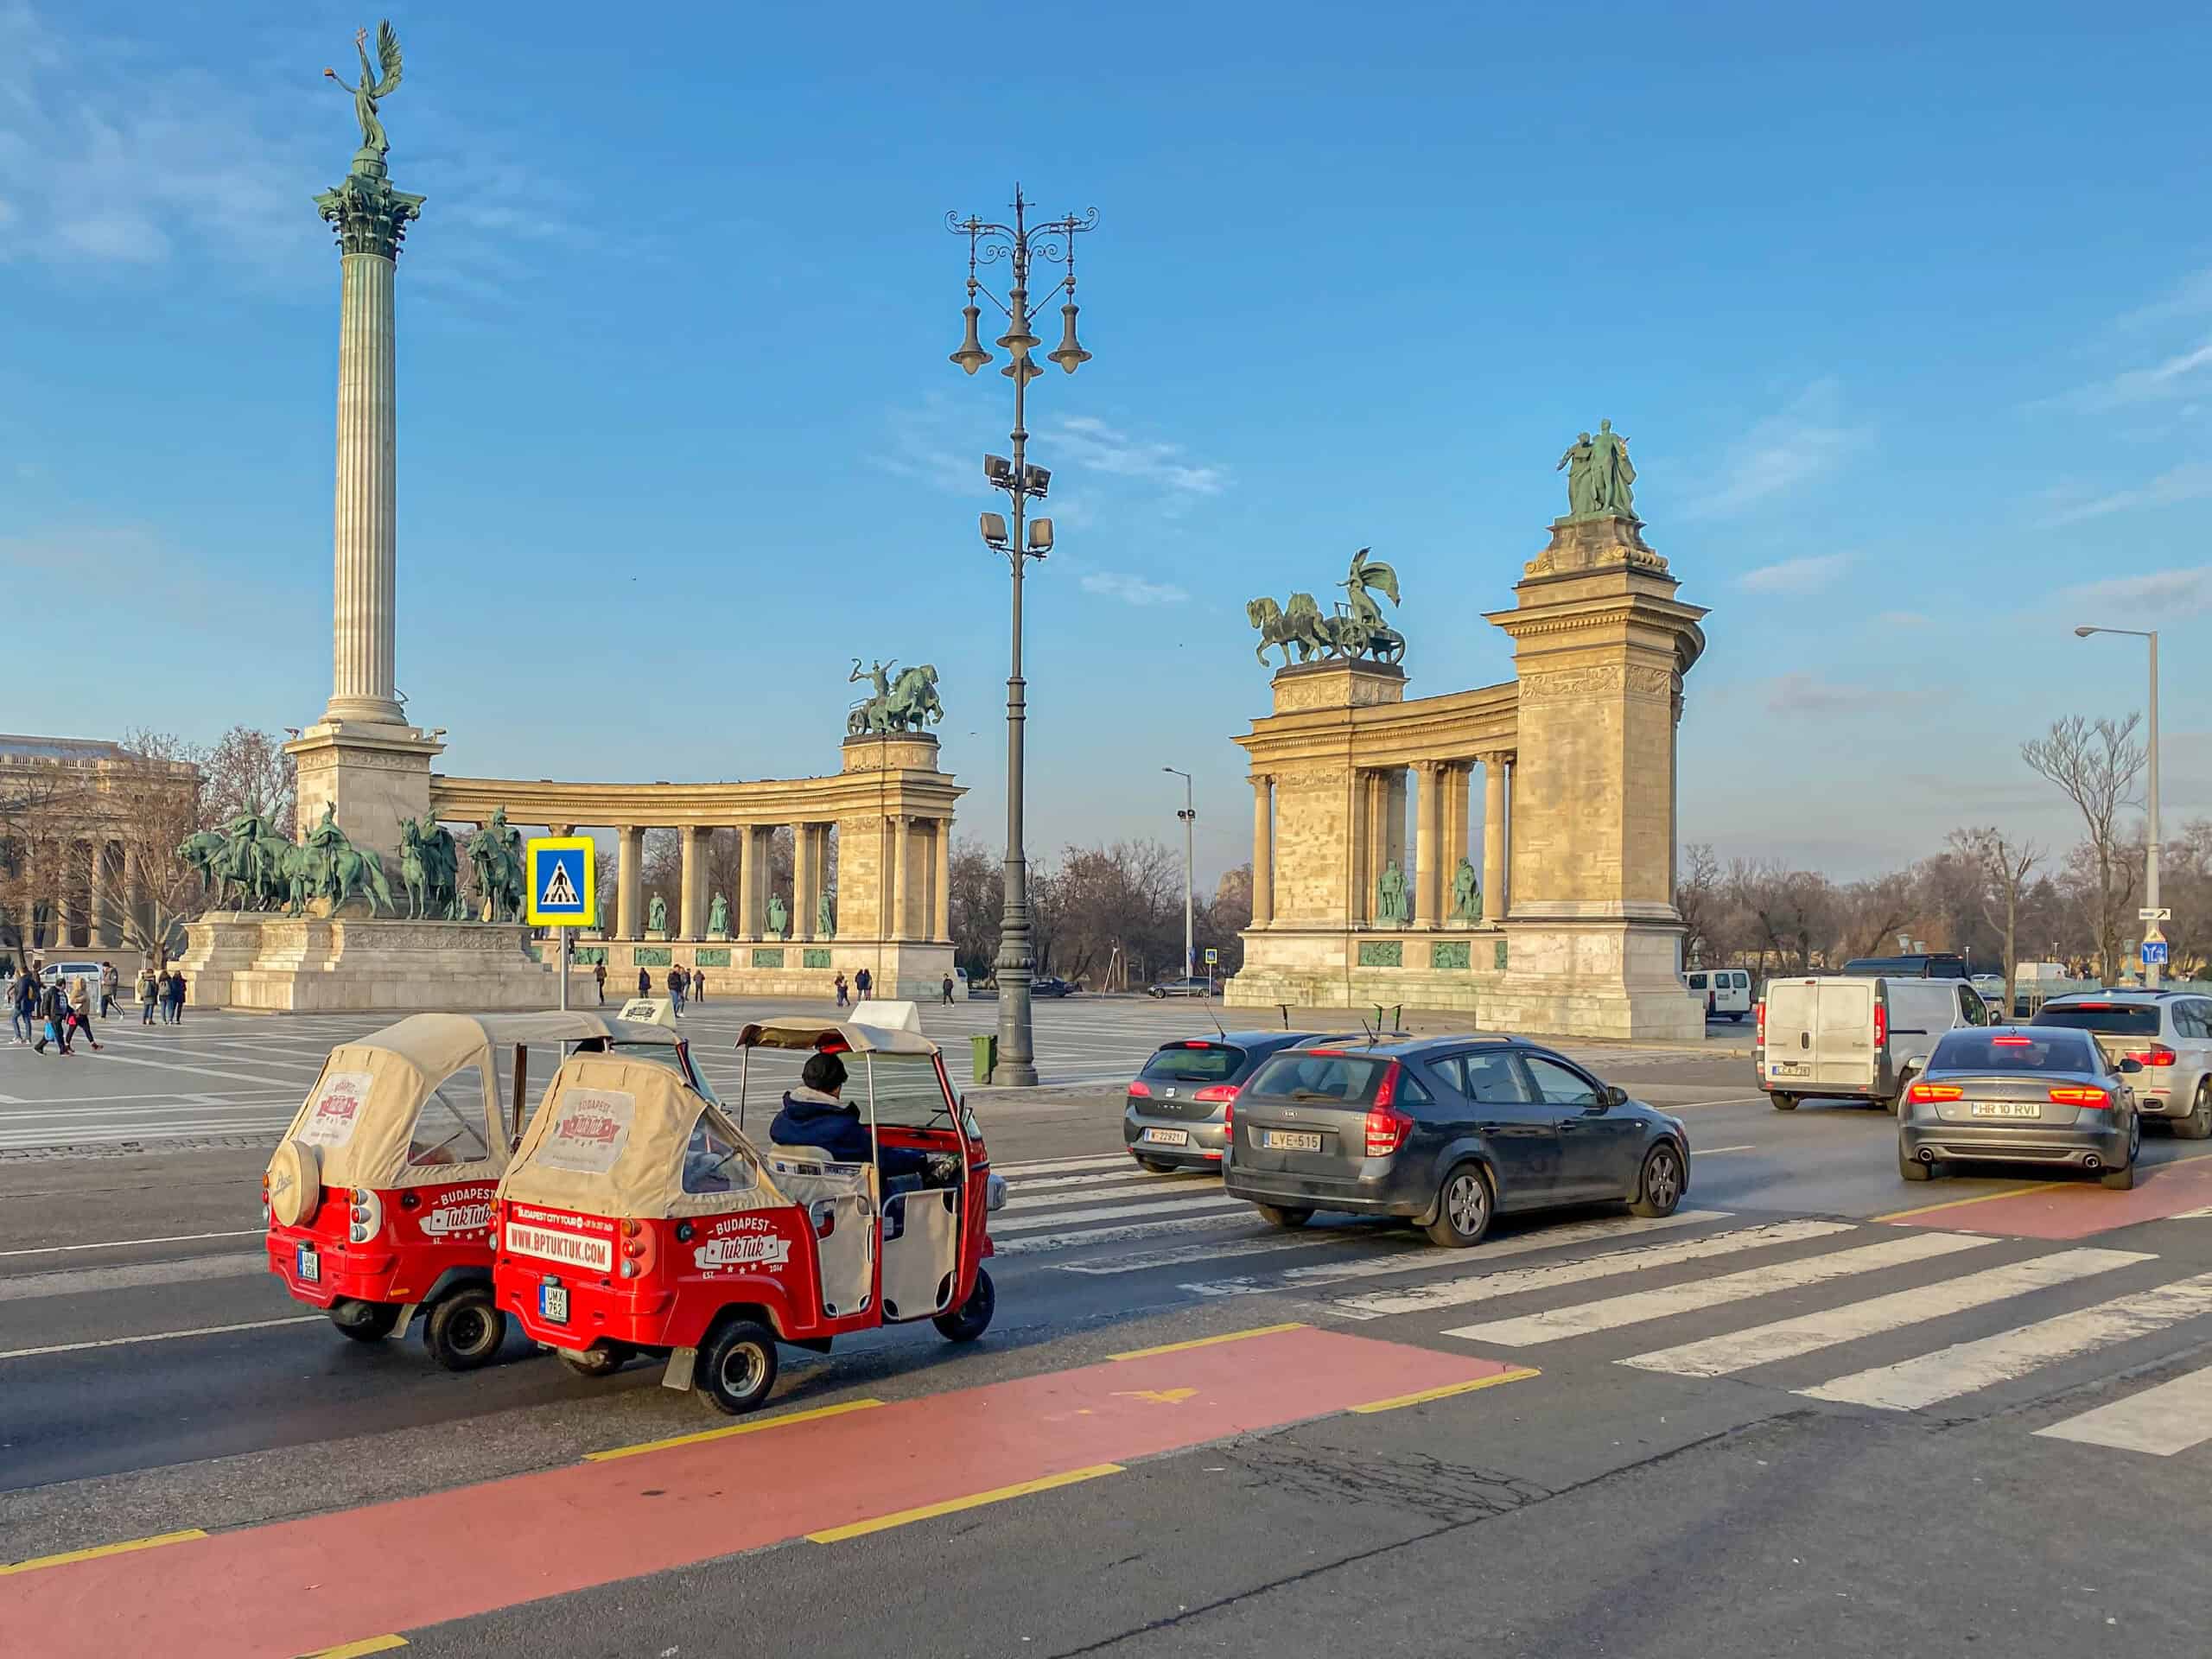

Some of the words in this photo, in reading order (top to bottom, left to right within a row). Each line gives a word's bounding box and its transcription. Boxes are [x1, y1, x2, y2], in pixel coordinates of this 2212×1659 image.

[1979, 1105, 1996, 1114] HR
[1999, 1105, 2011, 1114] 10
[2015, 1105, 2035, 1115] RVI
[1271, 1133, 1319, 1148] LYE-515
[441, 1188, 497, 1205] BUDAPEST
[518, 1209, 547, 1222] BUDAPEST
[547, 1213, 561, 1224] CITY
[561, 1216, 576, 1226] TOUR
[715, 1217, 770, 1236] BUDAPEST
[511, 1229, 606, 1265] WWW.BPTUKTUK.COM
[547, 1288, 563, 1302] UMX
